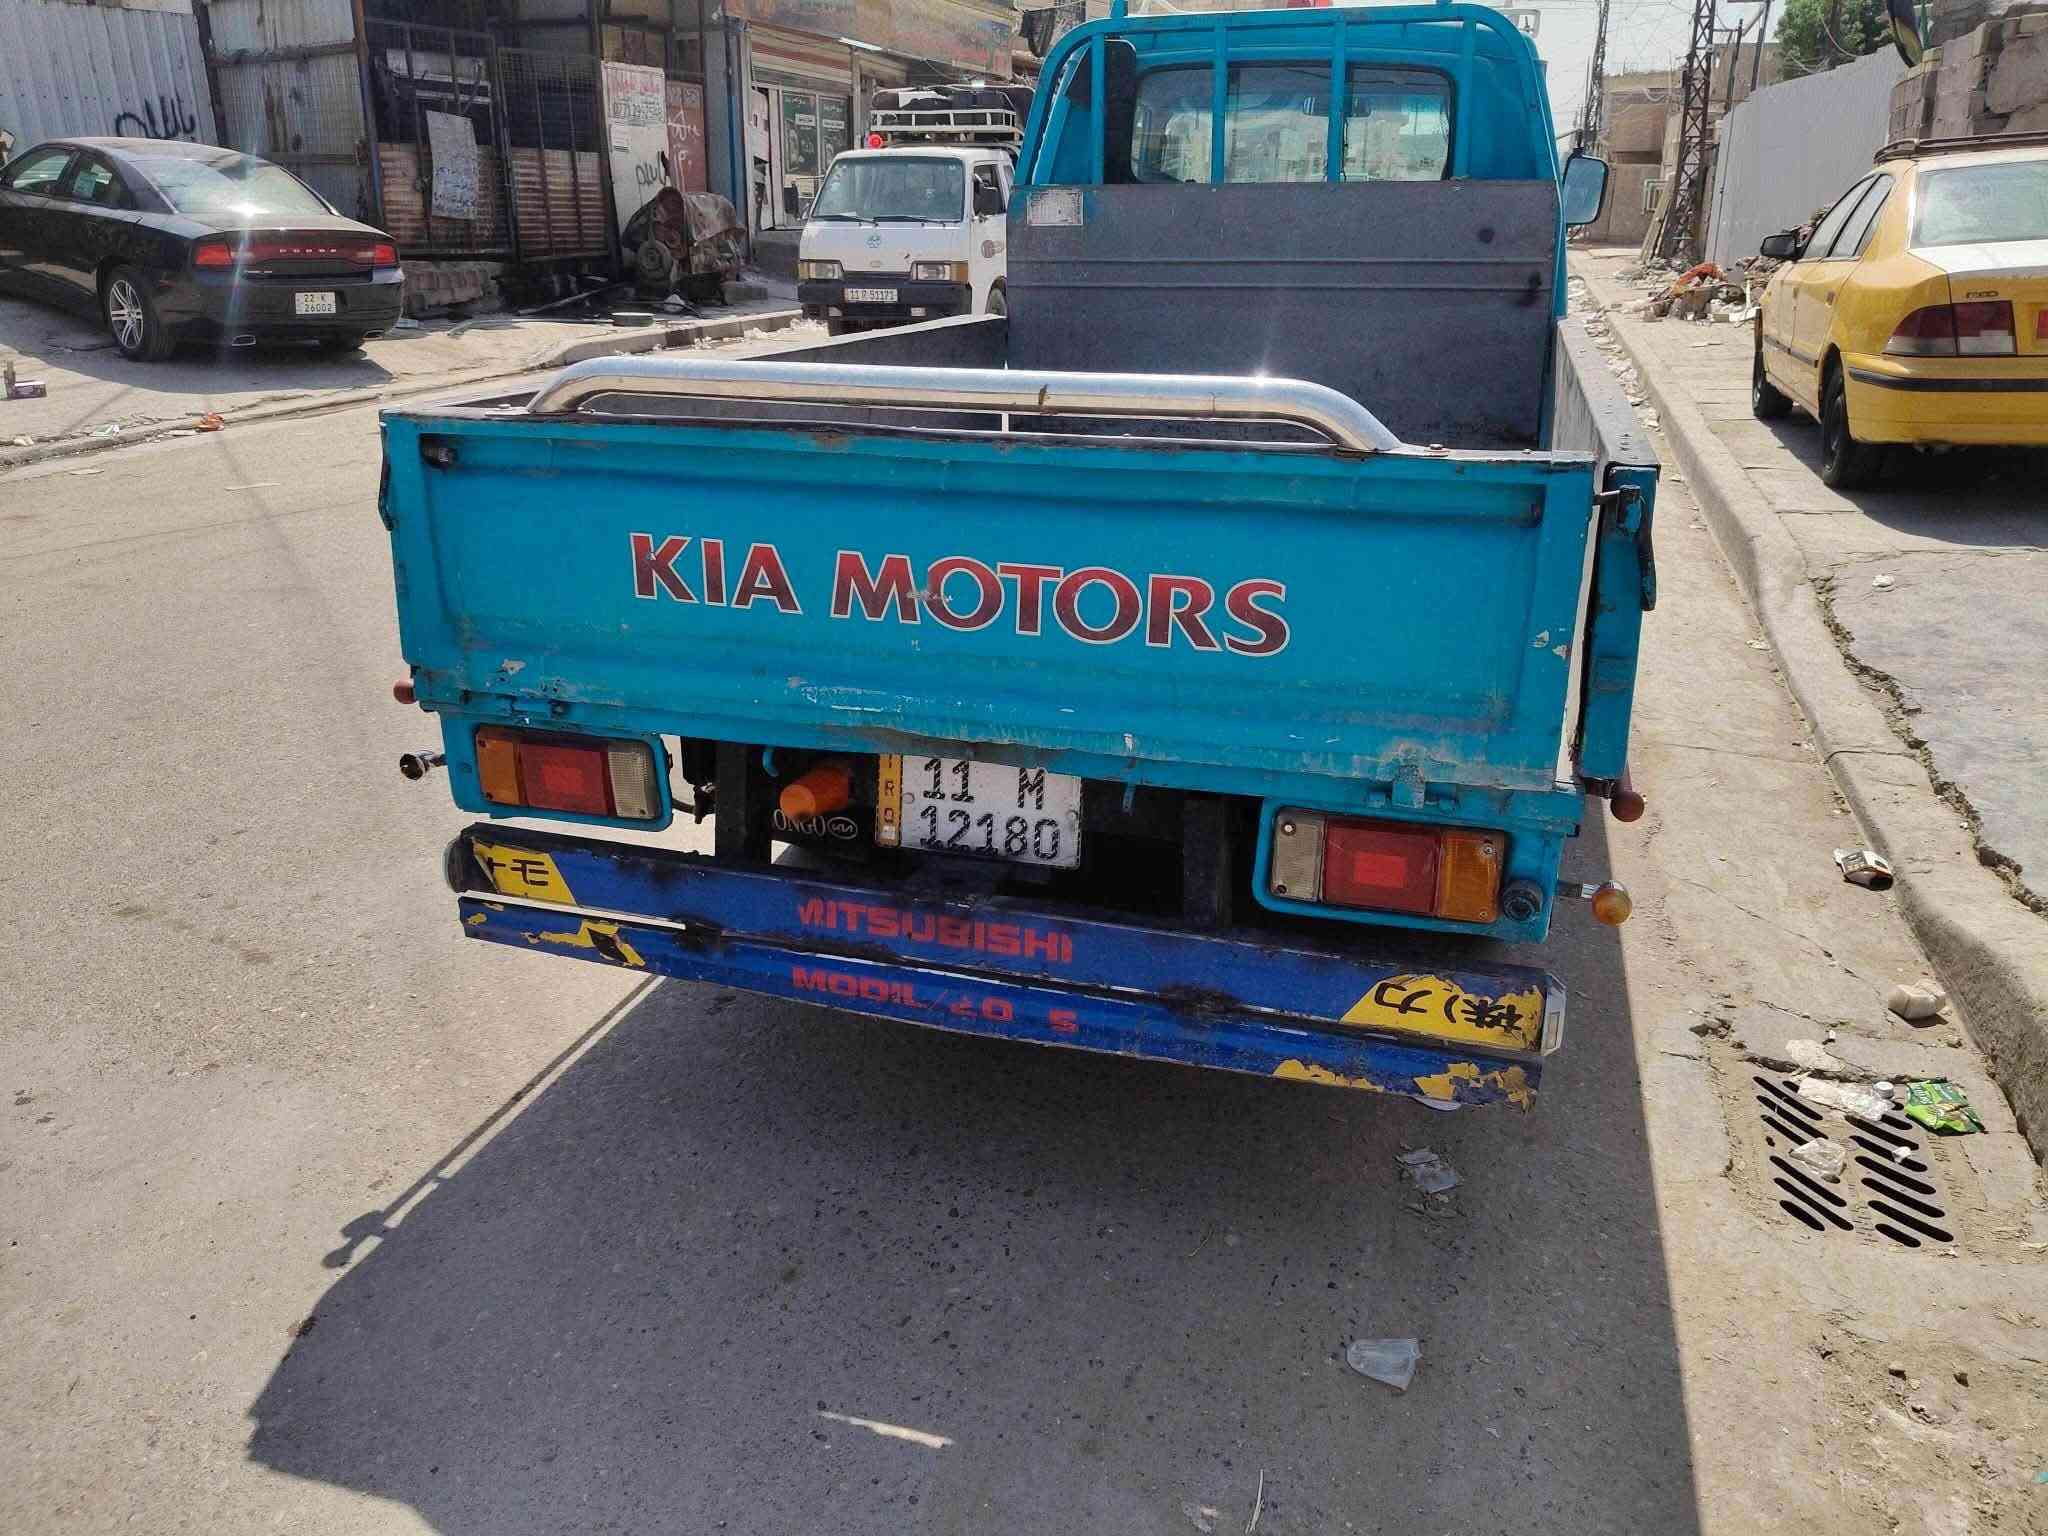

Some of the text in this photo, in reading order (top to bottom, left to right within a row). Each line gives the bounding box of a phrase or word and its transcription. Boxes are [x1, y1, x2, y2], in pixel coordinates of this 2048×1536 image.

[629, 532, 1291, 657] KIA MOTORS
[923, 758, 1047, 811] 11 M
[919, 804, 1061, 861] 12180
